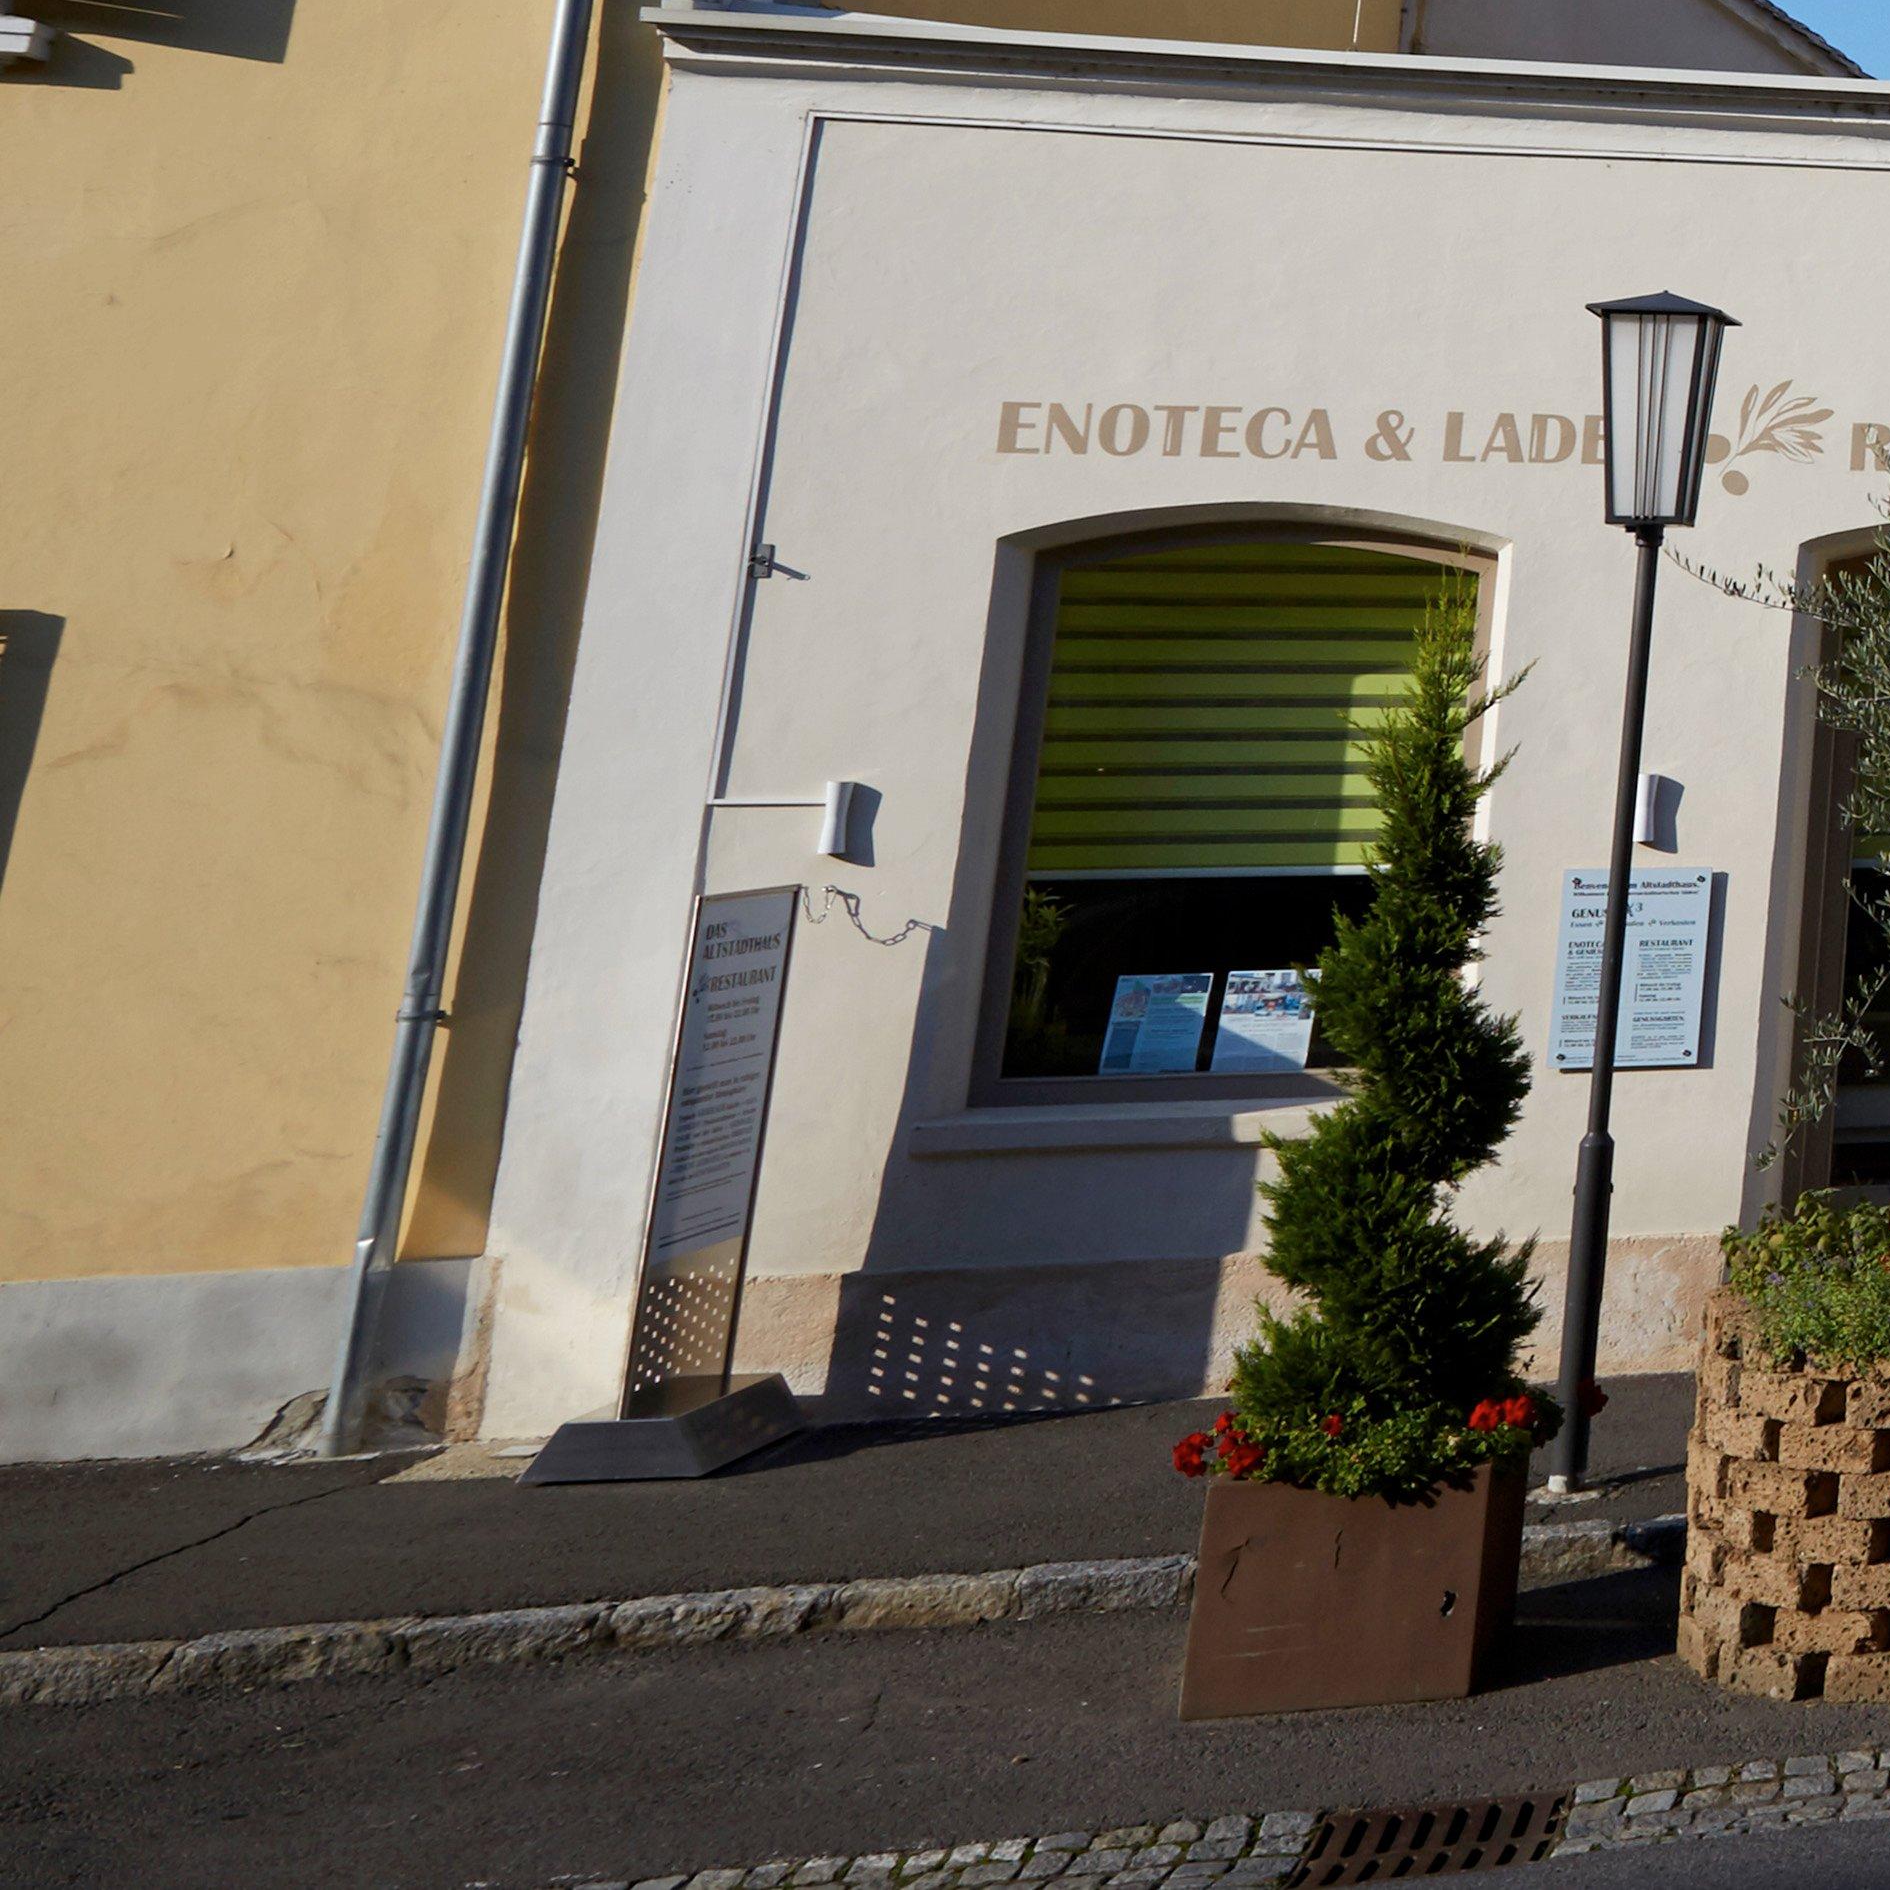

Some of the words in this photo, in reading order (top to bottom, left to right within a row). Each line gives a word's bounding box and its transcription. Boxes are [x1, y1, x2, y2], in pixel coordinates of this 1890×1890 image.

[996, 401, 1338, 460] ENOTECA
[1365, 409, 1415, 461] &
[1441, 411, 1605, 465] LADE
[705, 922, 728, 941] DAS
[703, 933, 781, 960] ALTSTADTHAUS
[1569, 941, 1603, 949] ENOTEC
[1638, 939, 1693, 947] RESTAURANT
[709, 966, 777, 992] RESTAURANT
